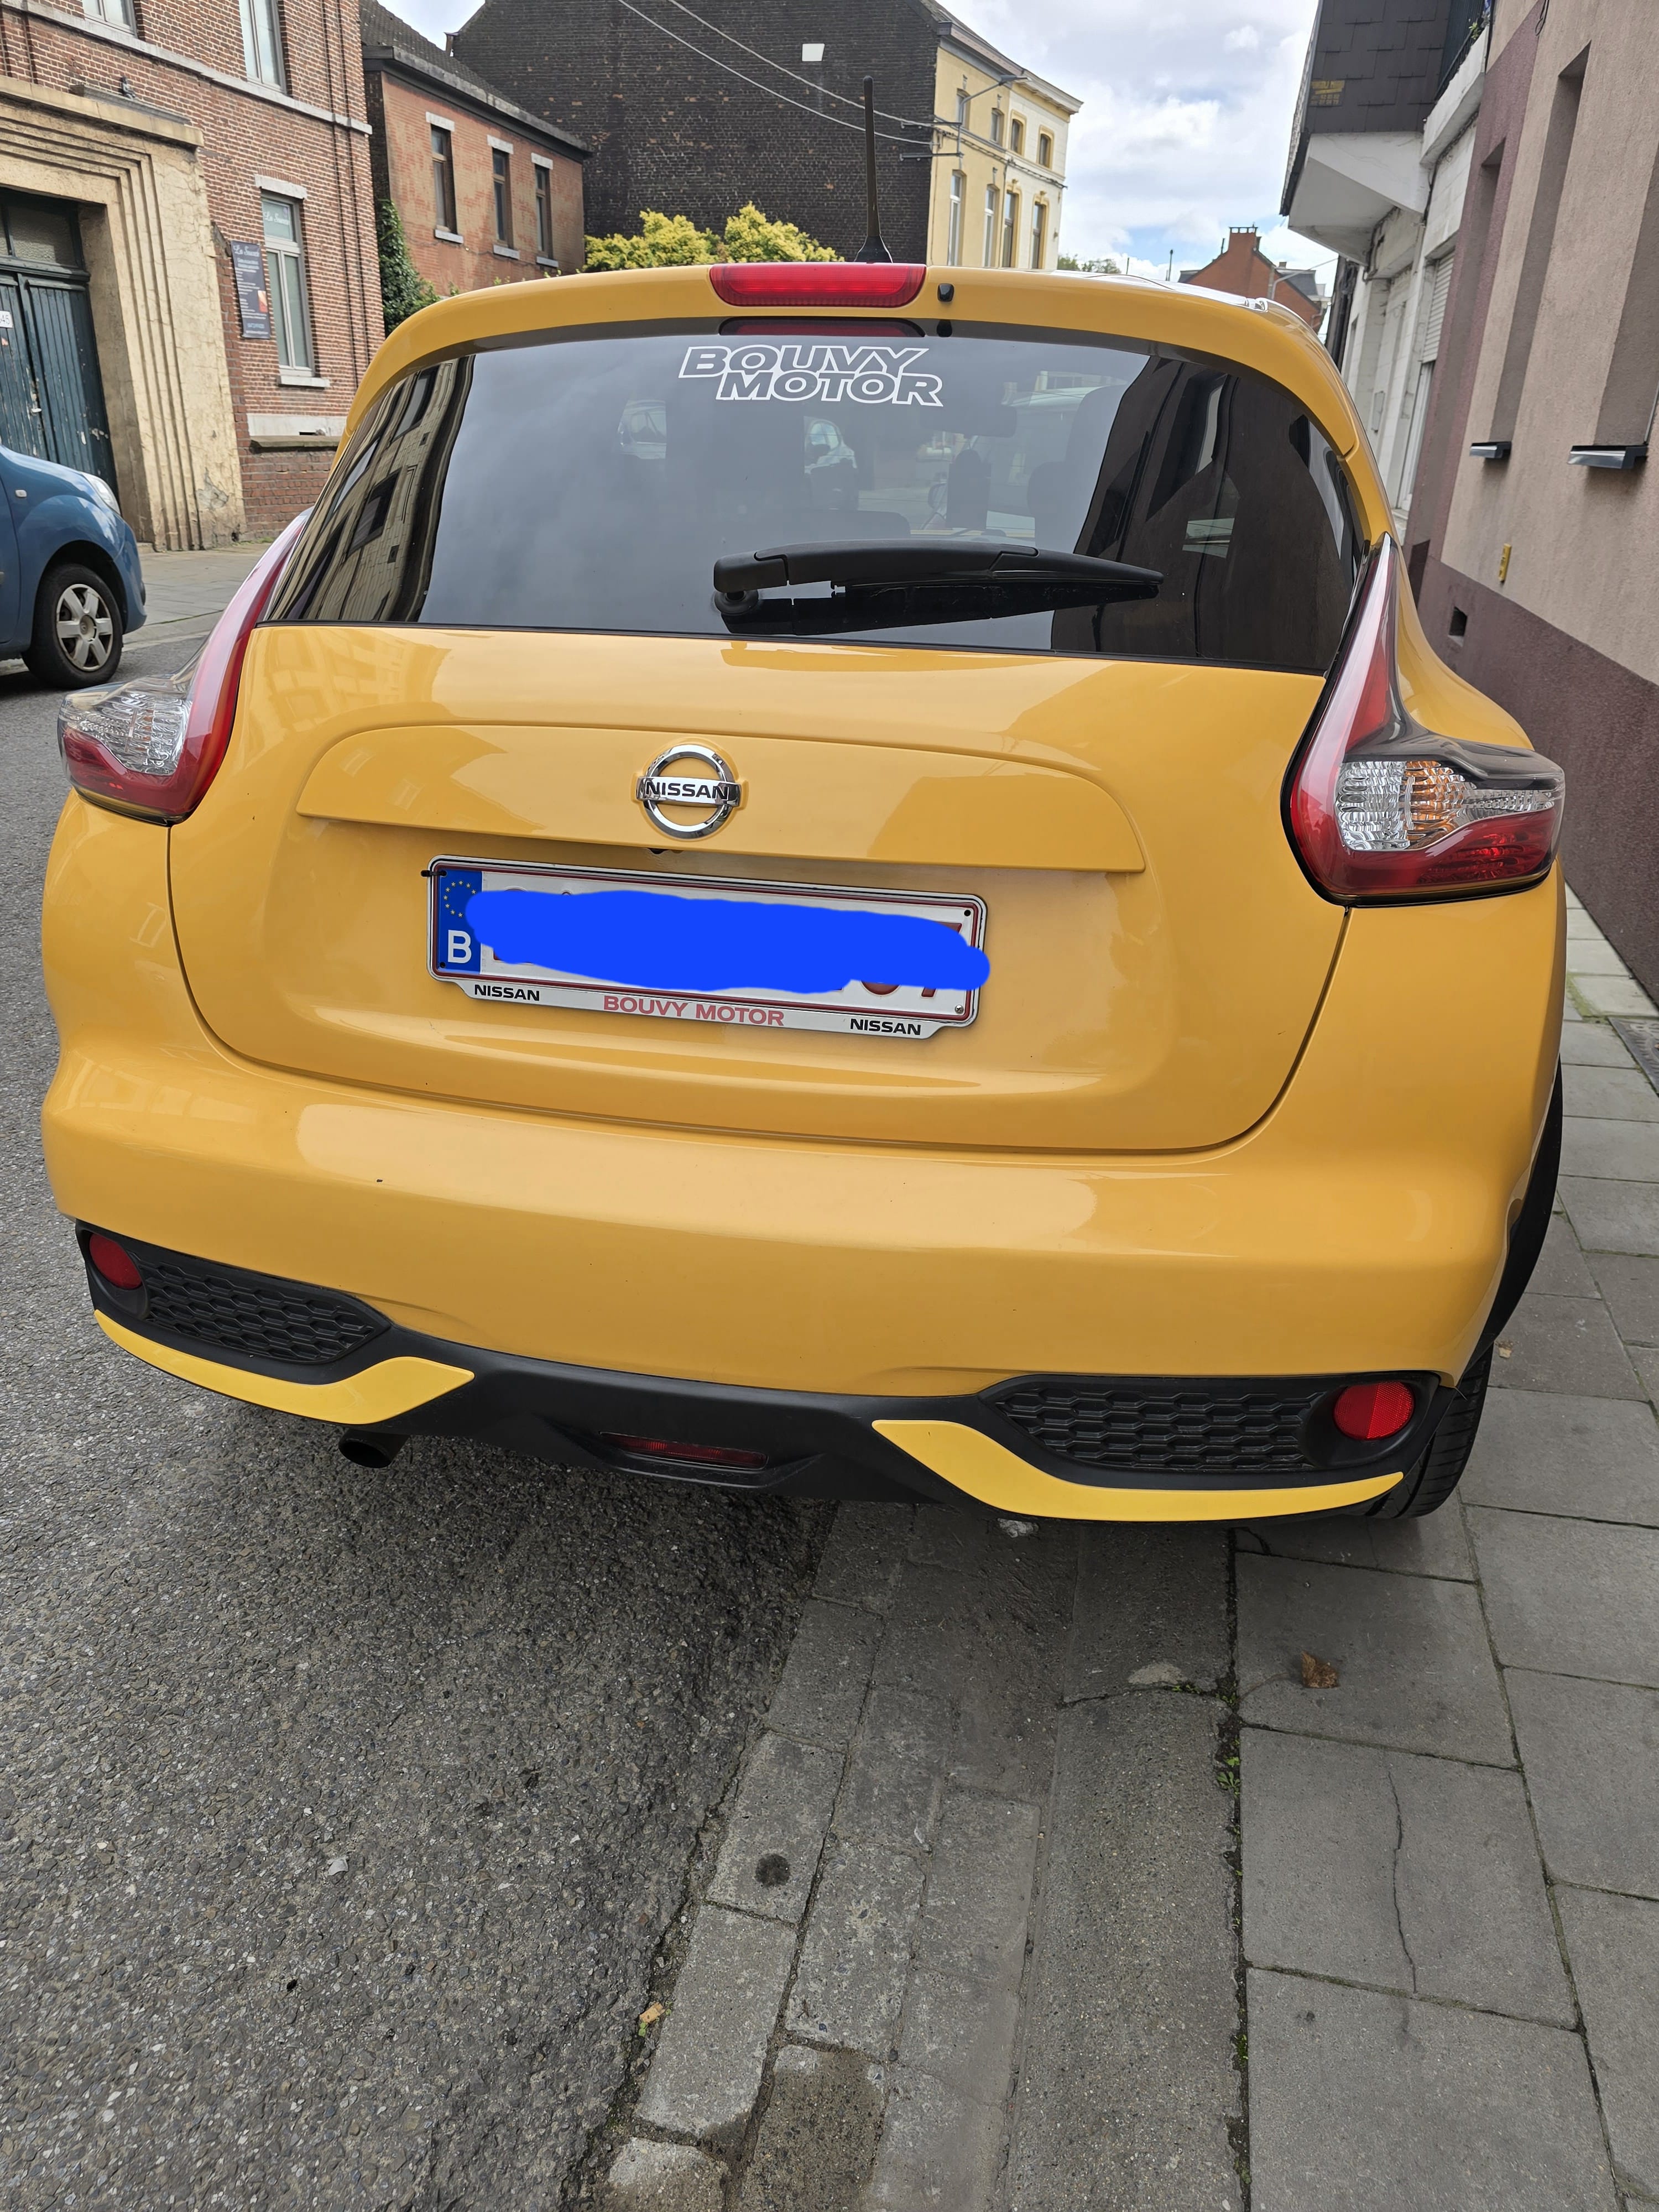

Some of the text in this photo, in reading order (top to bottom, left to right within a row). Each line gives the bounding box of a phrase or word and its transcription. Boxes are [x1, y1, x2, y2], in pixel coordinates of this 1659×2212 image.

[678, 345, 930, 378] BOUVY
[716, 370, 943, 407] MOTOR
[645, 781, 730, 801] NISSAN
[447, 929, 472, 963] B
[474, 984, 540, 1001] NISSAN
[603, 995, 784, 1026] BOUVY MOTOR
[850, 1018, 921, 1036] NISSAN
